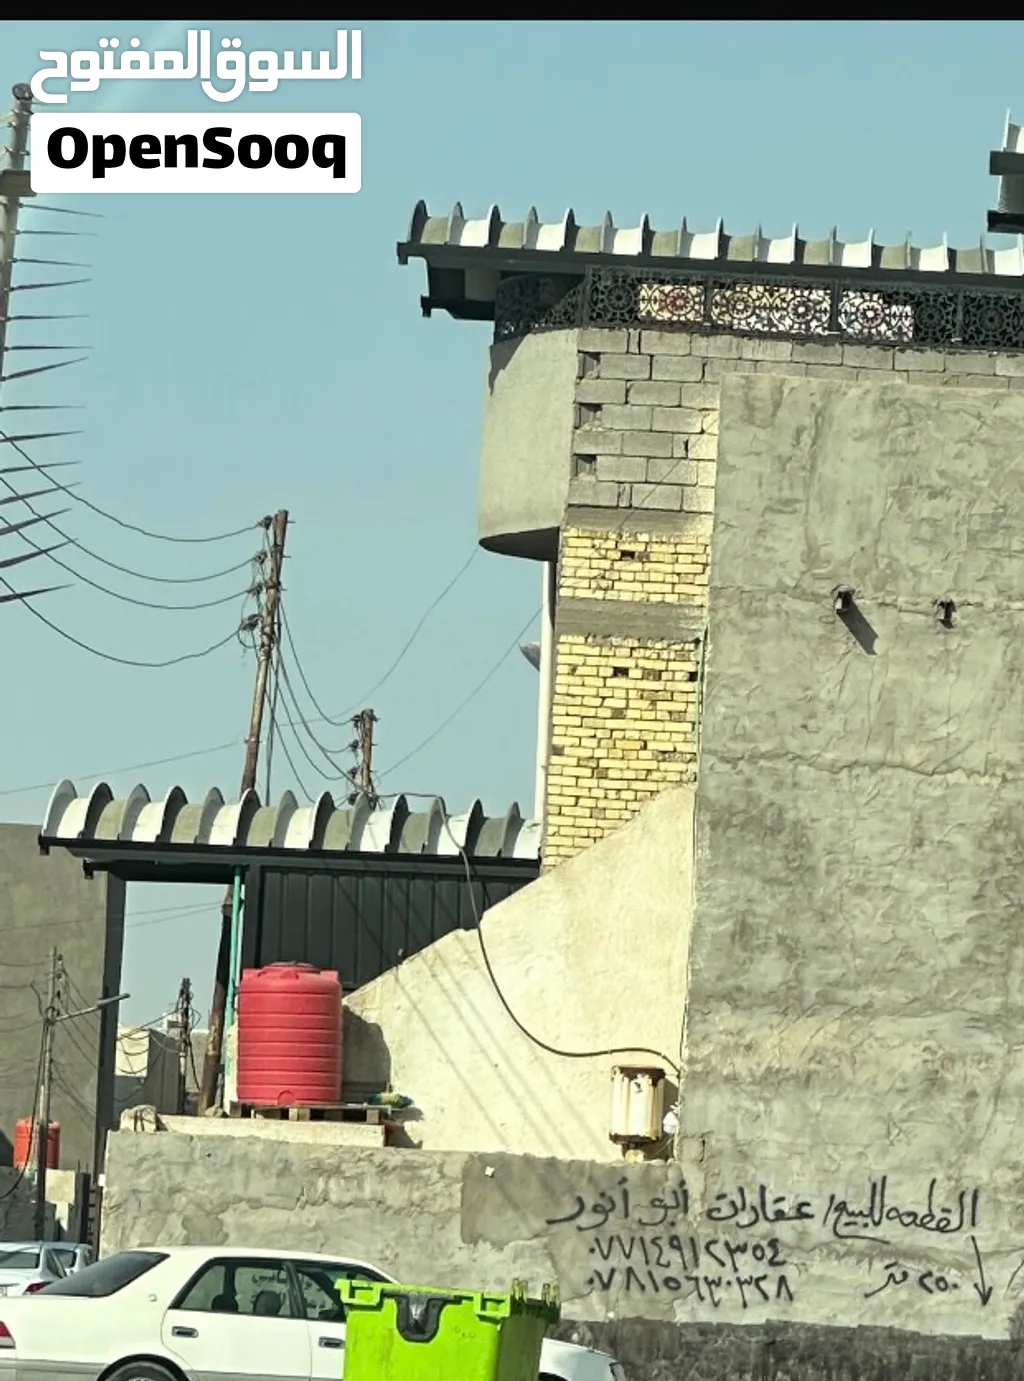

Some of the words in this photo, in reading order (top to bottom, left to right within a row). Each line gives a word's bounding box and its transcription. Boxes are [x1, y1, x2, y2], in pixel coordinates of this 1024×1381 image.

[706, 1184, 815, 1229] عقارات
[864, 1261, 910, 1298] متر
[918, 1270, 960, 1294] ٢٥٠
